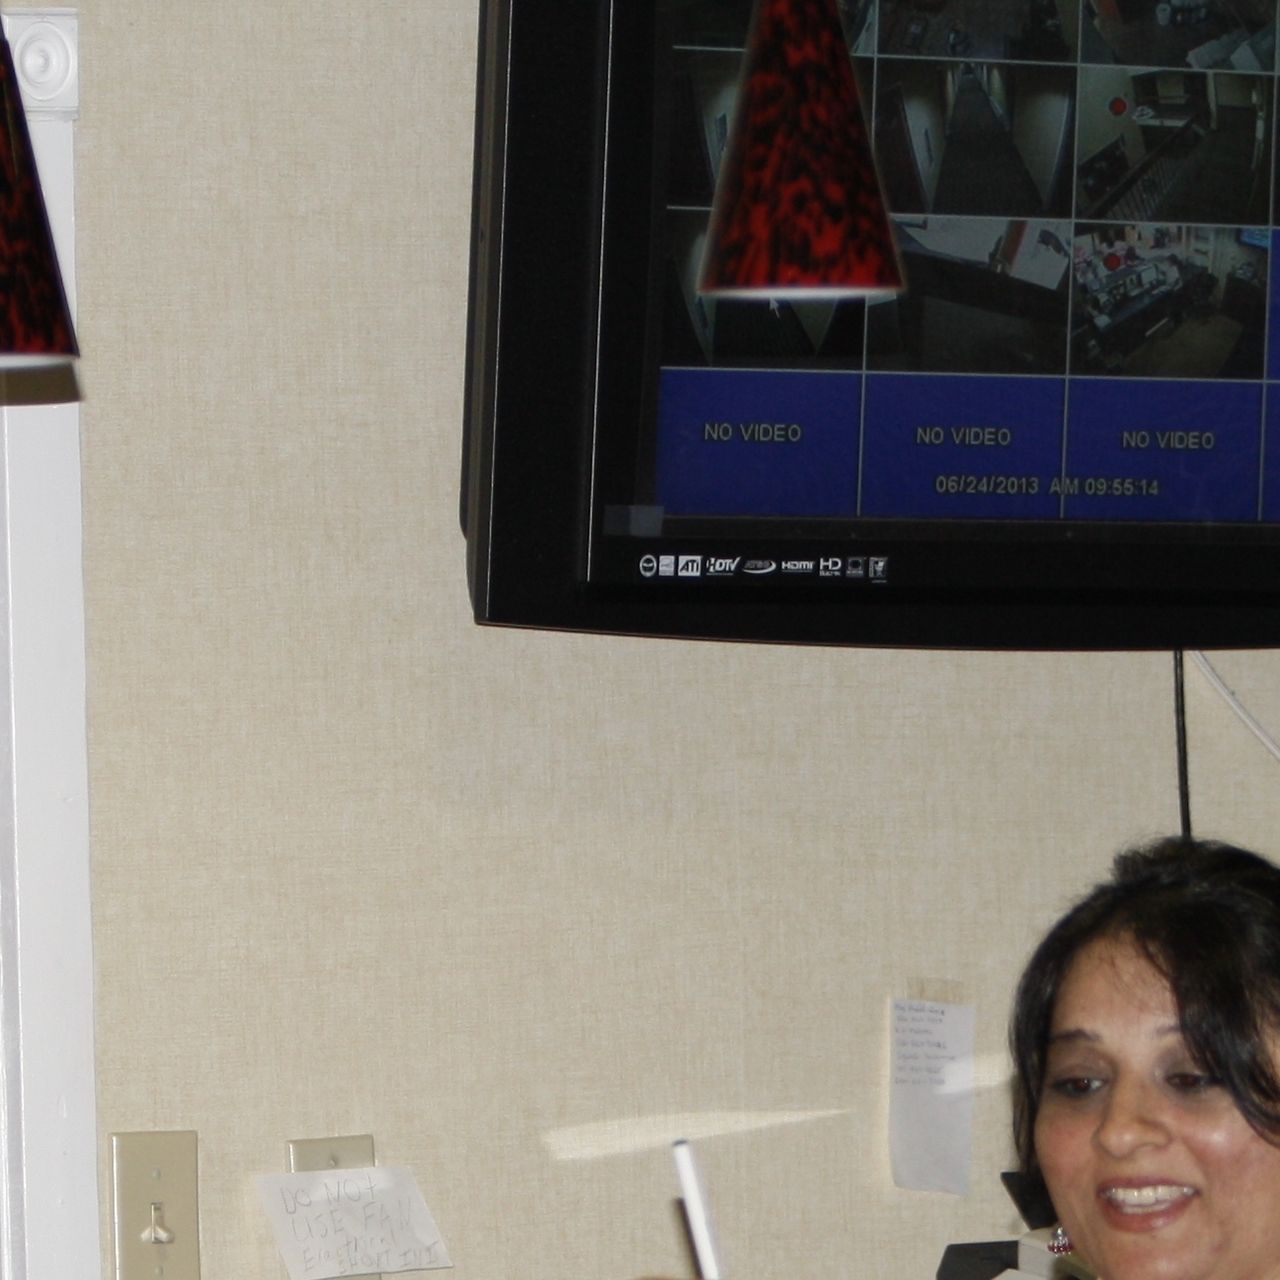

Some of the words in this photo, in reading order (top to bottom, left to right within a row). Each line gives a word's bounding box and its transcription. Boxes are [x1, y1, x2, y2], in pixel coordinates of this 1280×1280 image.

[704, 424, 732, 441] NO
[739, 424, 801, 442] VIDEO
[917, 427, 944, 444] NO
[951, 428, 1011, 445] VIDEO
[1123, 431, 1150, 448] NO
[1157, 432, 1214, 449] VIDEO
[935, 476, 1039, 494] 06/24/2013
[1049, 477, 1078, 495] AM
[1085, 478, 1159, 496] 09:55:14
